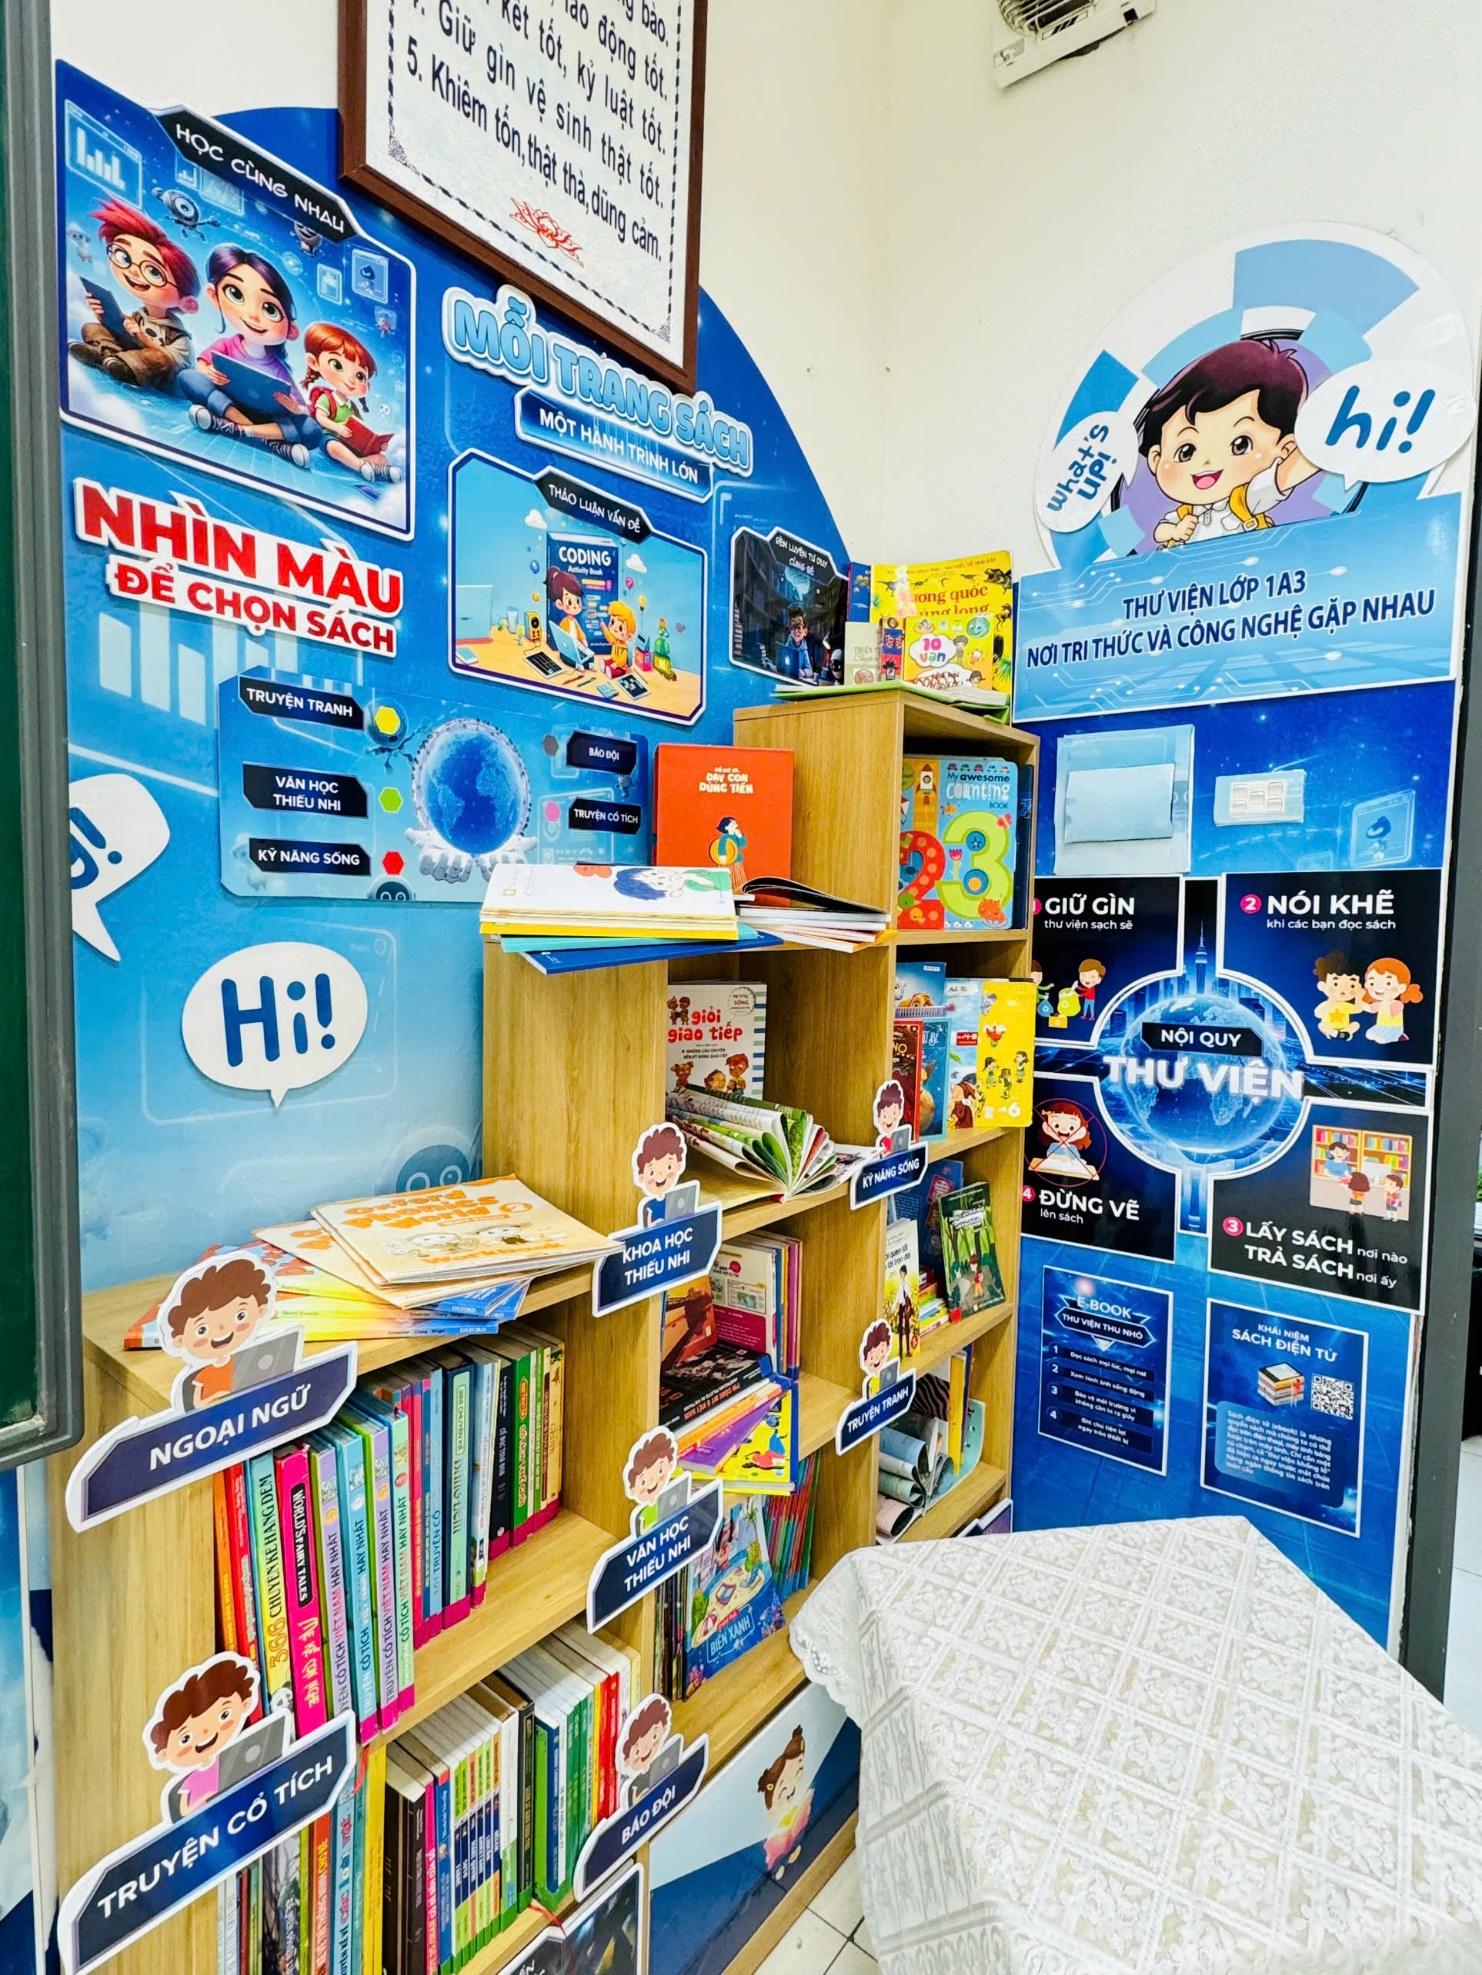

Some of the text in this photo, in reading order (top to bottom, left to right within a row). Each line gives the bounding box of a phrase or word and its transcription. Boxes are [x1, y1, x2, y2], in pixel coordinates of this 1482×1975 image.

[598, 14, 667, 101] động tốt.
[539, 19, 666, 155] tốt, kỷ luật tốt.
[439, 0, 663, 208] Giữ gìn vệ sinh thật tốt.
[407, 35, 662, 261] 5. Khiêm cảm.
[176, 123, 345, 233] HỌC CÙNG NHAU
[454, 296, 748, 467] MỖI TRANG SÁCH
[1325, 385, 1436, 454] hi!
[539, 408, 699, 485] MỘT HÀNH TRÌNH LỚN
[1047, 422, 1109, 513] what's
[1078, 452, 1117, 502] up!
[549, 483, 641, 533] THẢO LUẬN VẤN ĐỀ
[82, 484, 401, 615] NHÌN MÀU
[558, 546, 611, 566] CODING
[114, 562, 395, 653] ĐỂ CHỌN SÁCH
[950, 583, 988, 604] quốc
[1123, 570, 1306, 620] THƯ VIỆN LỚP 1A3
[922, 638, 942, 651] 10
[1026, 589, 1435, 668] NƠI TRI THỨC VÀ CÔNG NGHỆ GẶP NHAU
[246, 688, 353, 717] TRUYỆN TRANH
[275, 775, 339, 795] VĂN HỌC
[728, 774, 748, 782] CON
[946, 783, 1010, 801] counting
[947, 772, 1010, 782] My awesome
[273, 793, 341, 811] THIẾU NHI
[574, 809, 606, 822] TRUYỆN
[621, 813, 638, 824] TÍCH
[258, 847, 360, 865] KỸ NĂNG SỐNG
[1045, 893, 1134, 915] GIỮ GÌN
[1268, 889, 1394, 914] NÓI KHẼ
[1044, 919, 1133, 931] thư viện sạch sẽ
[1266, 918, 1396, 931] khi các bạn đọc sách
[221, 973, 336, 1067] Hi!
[668, 1021, 743, 1043] giao tiếp
[691, 1006, 721, 1026] giỏi
[1161, 1028, 1240, 1048] NỘI QUY
[1103, 1055, 1304, 1103] THƯ VIỆN
[862, 1158, 920, 1189] KỸ NĂNG SỐNG
[342, 1196, 499, 1229] Phonics
[346, 1190, 467, 1215] Oxford
[383, 1206, 491, 1229] World
[1039, 1188, 1140, 1221] ĐỪNG VẼ
[1040, 1209, 1084, 1225] lên sách
[421, 1242, 561, 1266] Workbook
[622, 1227, 694, 1264] KHOA HỌC
[1246, 1220, 1408, 1265] LẤY SÁCH nơi nào
[624, 1250, 690, 1286] THIẾU NHI
[1245, 1243, 1397, 1289] TRẢ SÁCH nơi ấy
[1077, 1297, 1132, 1319] E-BOOK
[1062, 1313, 1143, 1339] THƯ VIỆN THU NHỎ
[1258, 1324, 1309, 1343] KHÁI NIỆM
[1232, 1328, 1338, 1362] SÁCH ĐIỆN TỬ
[847, 1386, 909, 1433] TRUYỆN TRANH
[148, 1383, 311, 1471] NGOẠI NGỮ
[379, 1509, 389, 1539] NHẤT
[381, 1540, 390, 1562] HAY
[626, 1516, 689, 1567] VĂN HỌC
[382, 1562, 390, 1590] NAM
[624, 1535, 691, 1593] THIẾU NHI
[267, 1617, 288, 1667] 366
[382, 1616, 393, 1642] TÍCH
[728, 1615, 751, 1641] XANH
[622, 1785, 676, 1844] BÁO ĐỘI
[97, 1755, 333, 1919] TRUYỆN CỔ TÍCH
